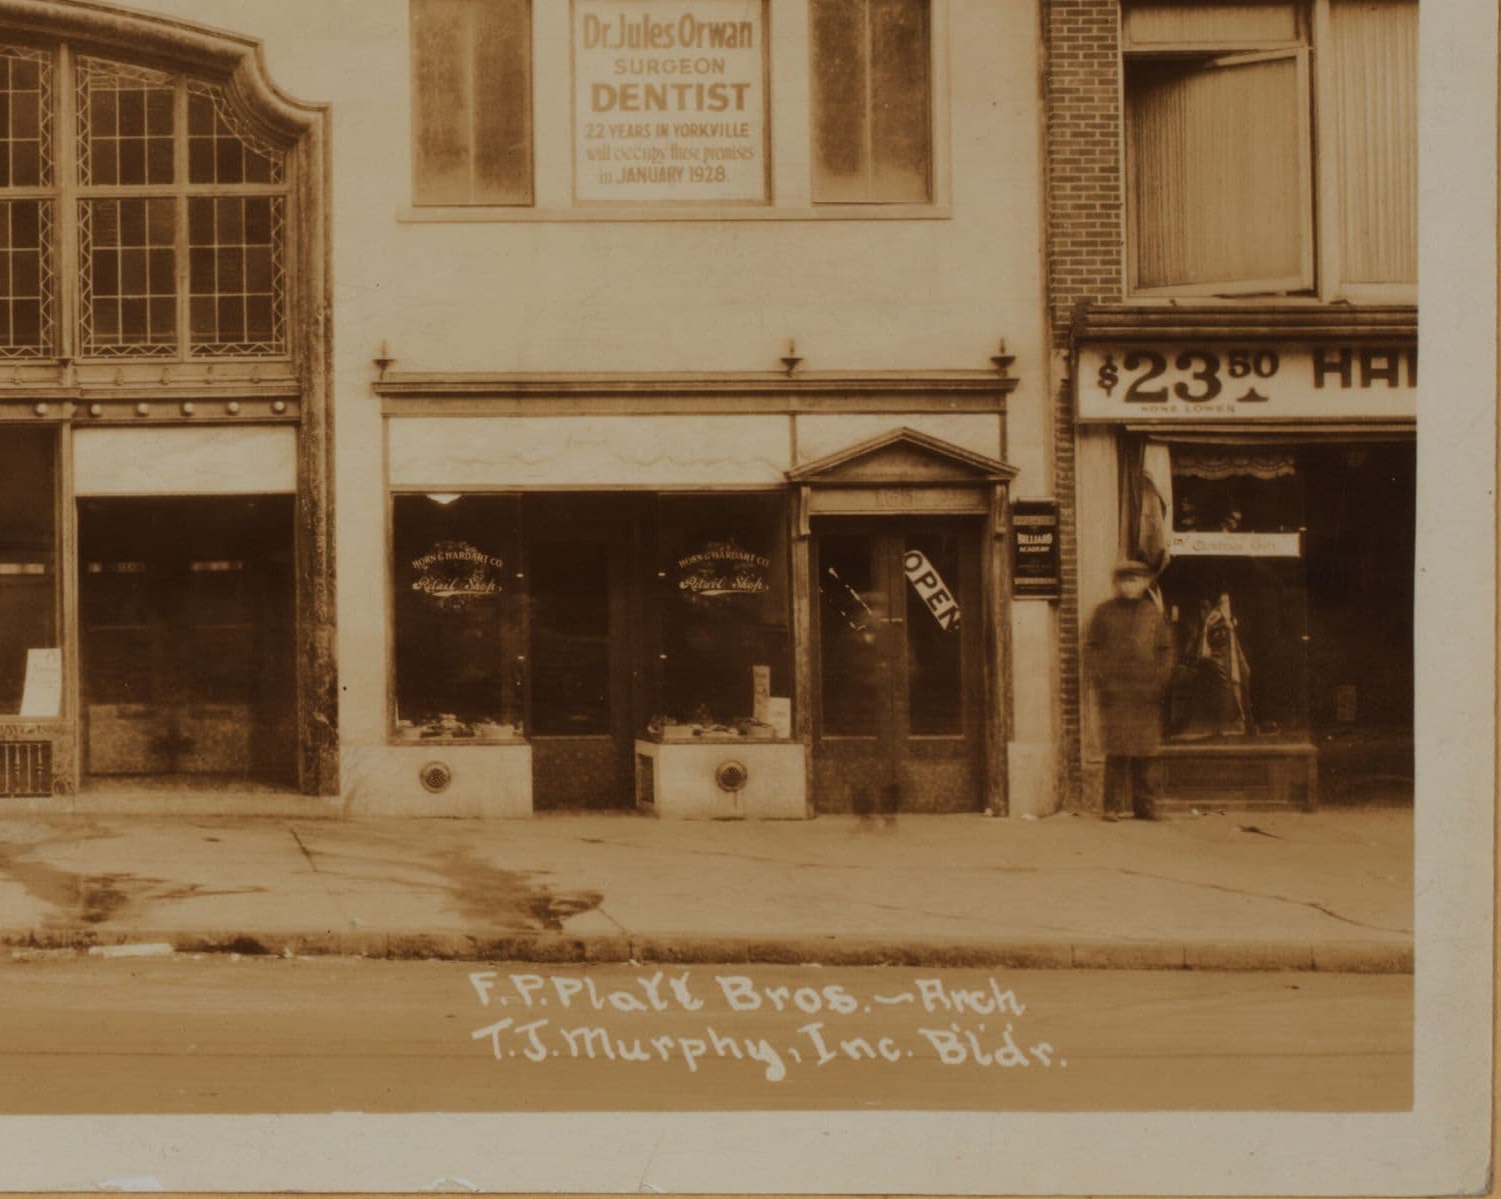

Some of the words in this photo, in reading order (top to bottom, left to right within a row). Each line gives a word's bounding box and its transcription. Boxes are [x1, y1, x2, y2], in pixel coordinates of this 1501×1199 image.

[583, 13, 613, 49] Dr.
[614, 13, 676, 49] Jules
[679, 12, 753, 49] Orwan
[613, 57, 726, 76] SURGEON
[591, 82, 751, 113] DENTIST
[585, 123, 605, 139] 22
[609, 122, 652, 139] YEARS
[656, 122, 669, 138] IN
[673, 121, 749, 138] YORKVILLE
[615, 165, 685, 185] JANUARY
[1141, 405, 1178, 414] NONE
[1183, 405, 1236, 414] LOWER
[904, 553, 960, 630] OPEN
